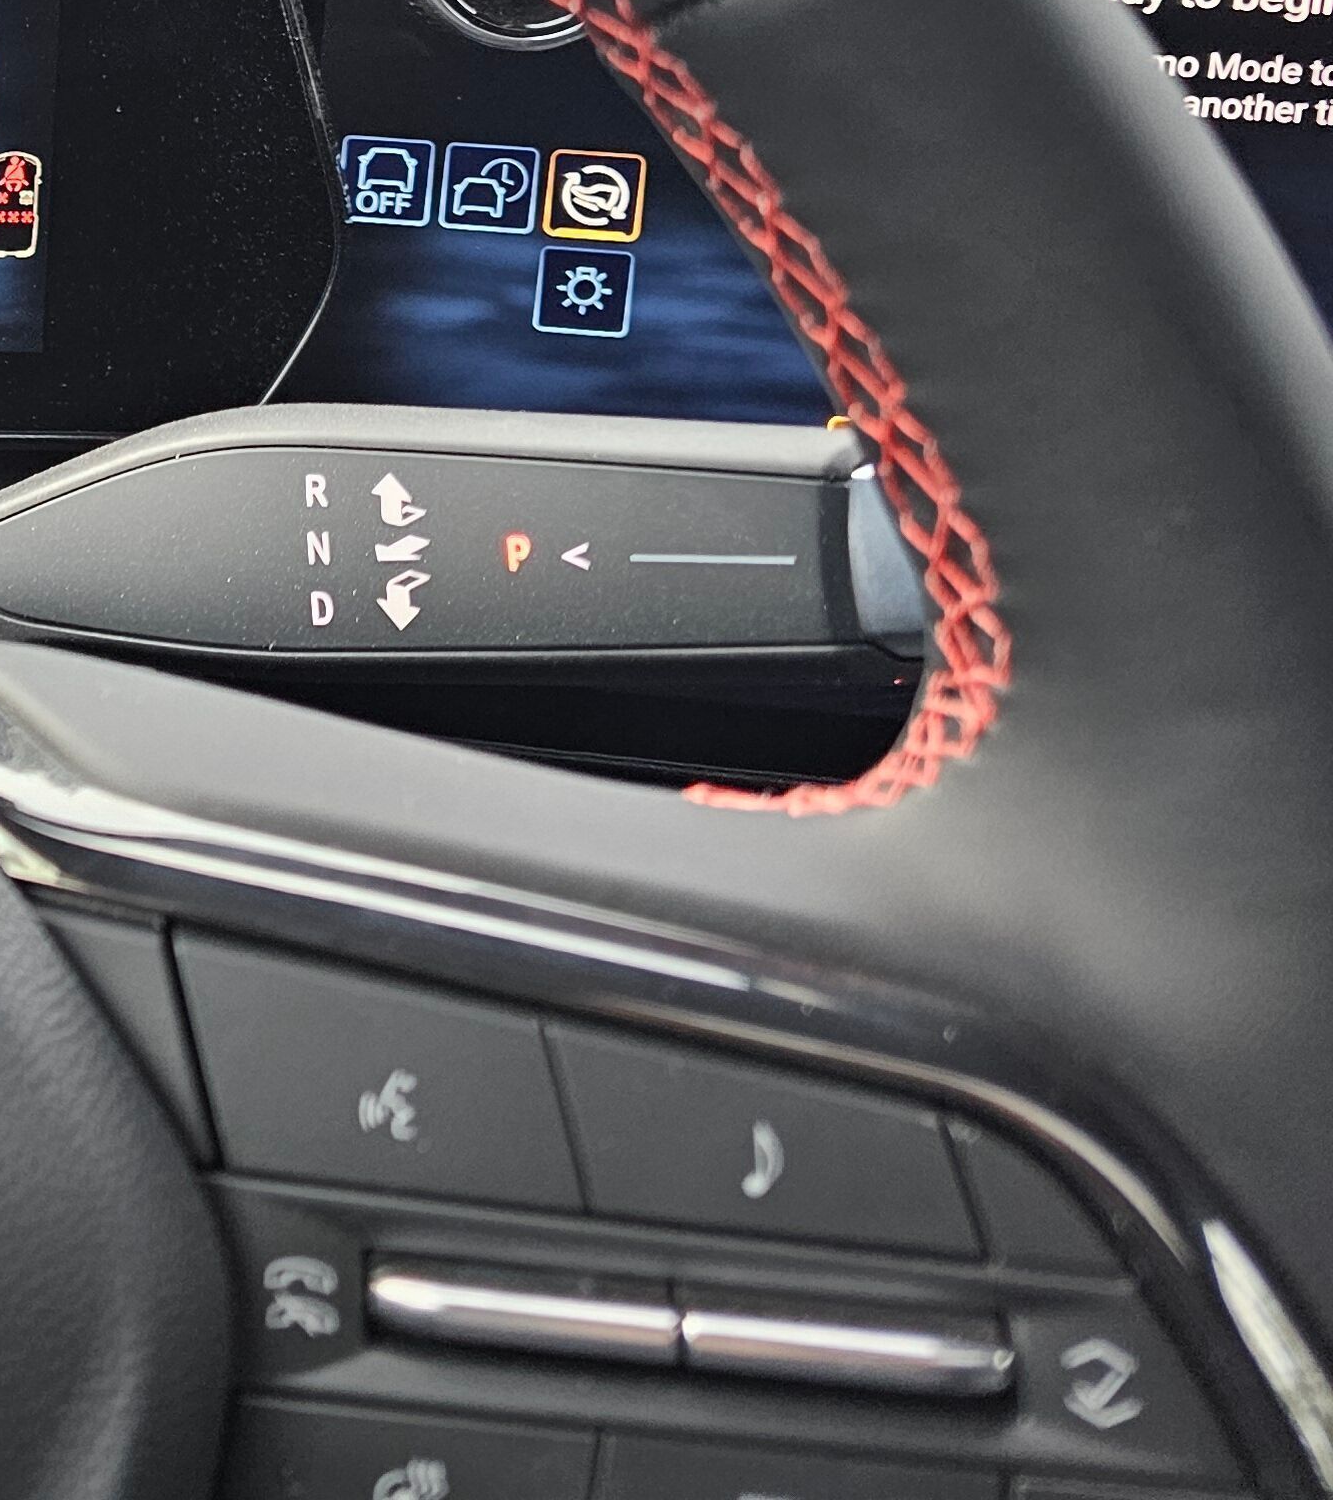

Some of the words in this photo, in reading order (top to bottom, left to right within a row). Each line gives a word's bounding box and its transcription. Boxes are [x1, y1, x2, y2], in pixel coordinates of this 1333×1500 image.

[1154, 53, 1200, 78] mo
[1207, 51, 1304, 85] Mode
[1183, 92, 1309, 124] another
[355, 190, 414, 215] OFF
[304, 473, 330, 508] R
[306, 530, 332, 567] N
[504, 533, 532, 573] P
[309, 590, 335, 626] D
